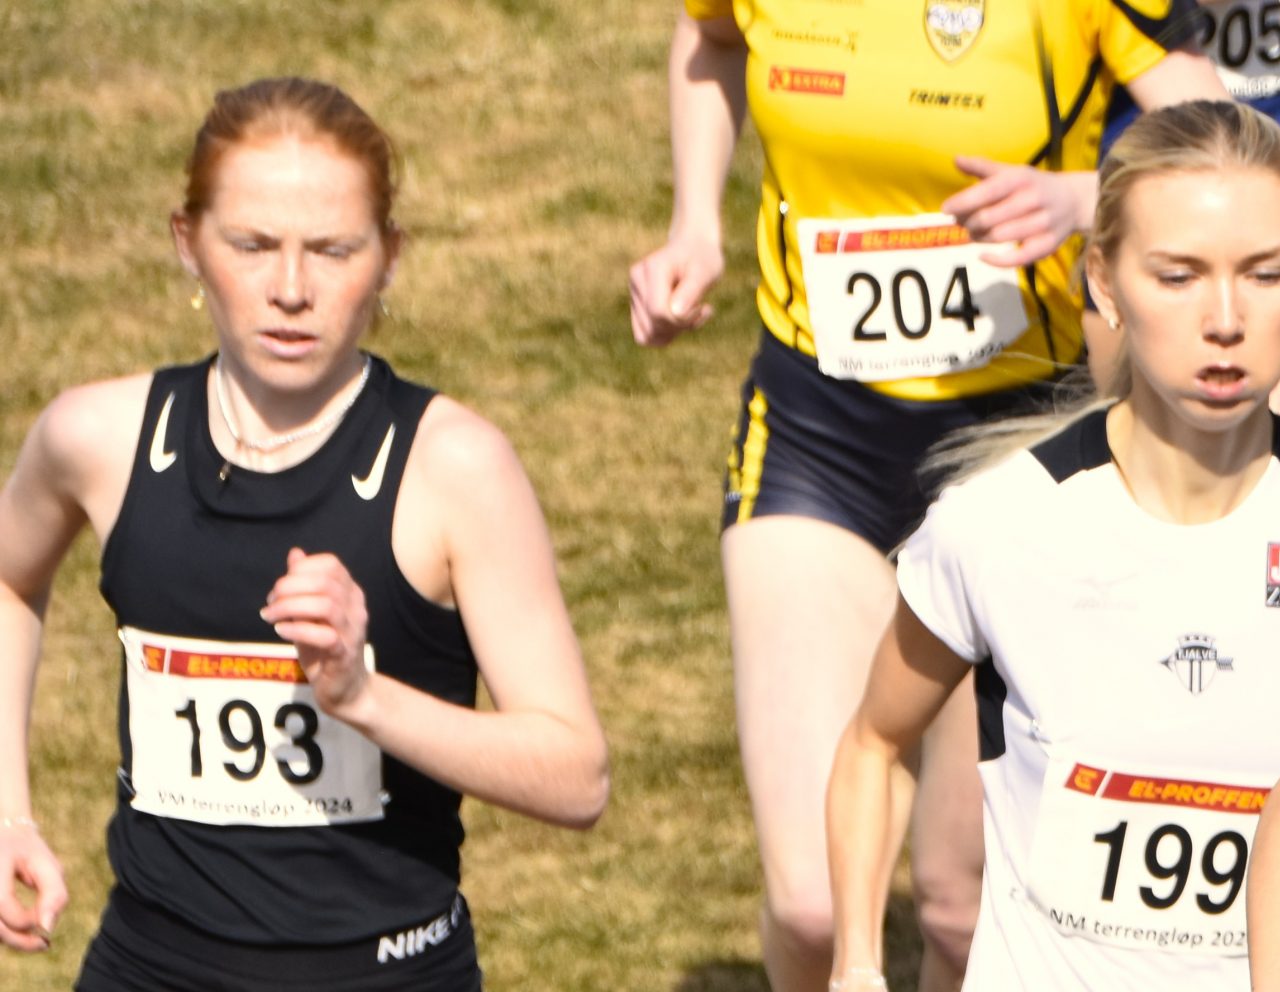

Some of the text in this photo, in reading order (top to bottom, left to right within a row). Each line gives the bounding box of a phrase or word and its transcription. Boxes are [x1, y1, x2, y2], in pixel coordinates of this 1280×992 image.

[908, 88, 986, 109] TRIMTEX
[847, 264, 980, 341] 204
[175, 699, 323, 785] 193
[1094, 820, 1248, 915] 199
[377, 912, 450, 964] NIKE
[1050, 907, 1086, 931] NM
[1094, 920, 1203, 948] terrengløp
